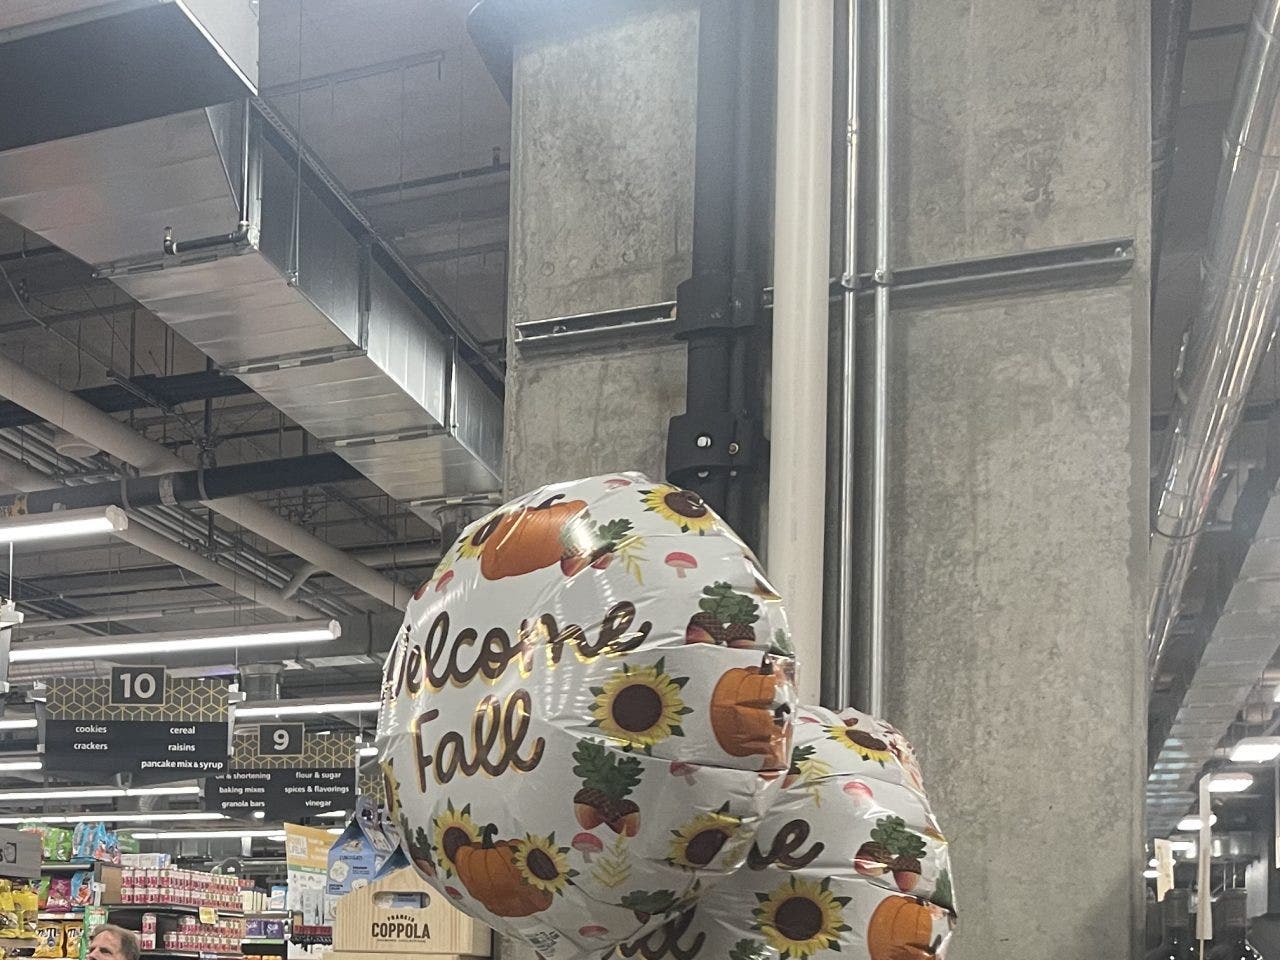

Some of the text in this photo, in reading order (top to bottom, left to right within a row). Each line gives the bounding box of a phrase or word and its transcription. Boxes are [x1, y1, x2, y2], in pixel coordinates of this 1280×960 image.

[120, 673, 156, 700] 10
[75, 724, 107, 734] cookies
[170, 726, 195, 735] cereal
[273, 729, 290, 751] 9
[411, 689, 545, 793] Fall
[73, 741, 108, 751] crackers
[168, 742, 195, 752] raisins
[141, 759, 176, 770] pancake
[177, 760, 192, 769] mix
[199, 760, 223, 770] syrup
[233, 772, 270, 780] shortening
[321, 772, 341, 780] sugar
[314, 785, 349, 794] flavorings
[222, 801, 248, 809] granola
[305, 801, 332, 809] vinegar
[372, 923, 431, 939] COPPOLA
